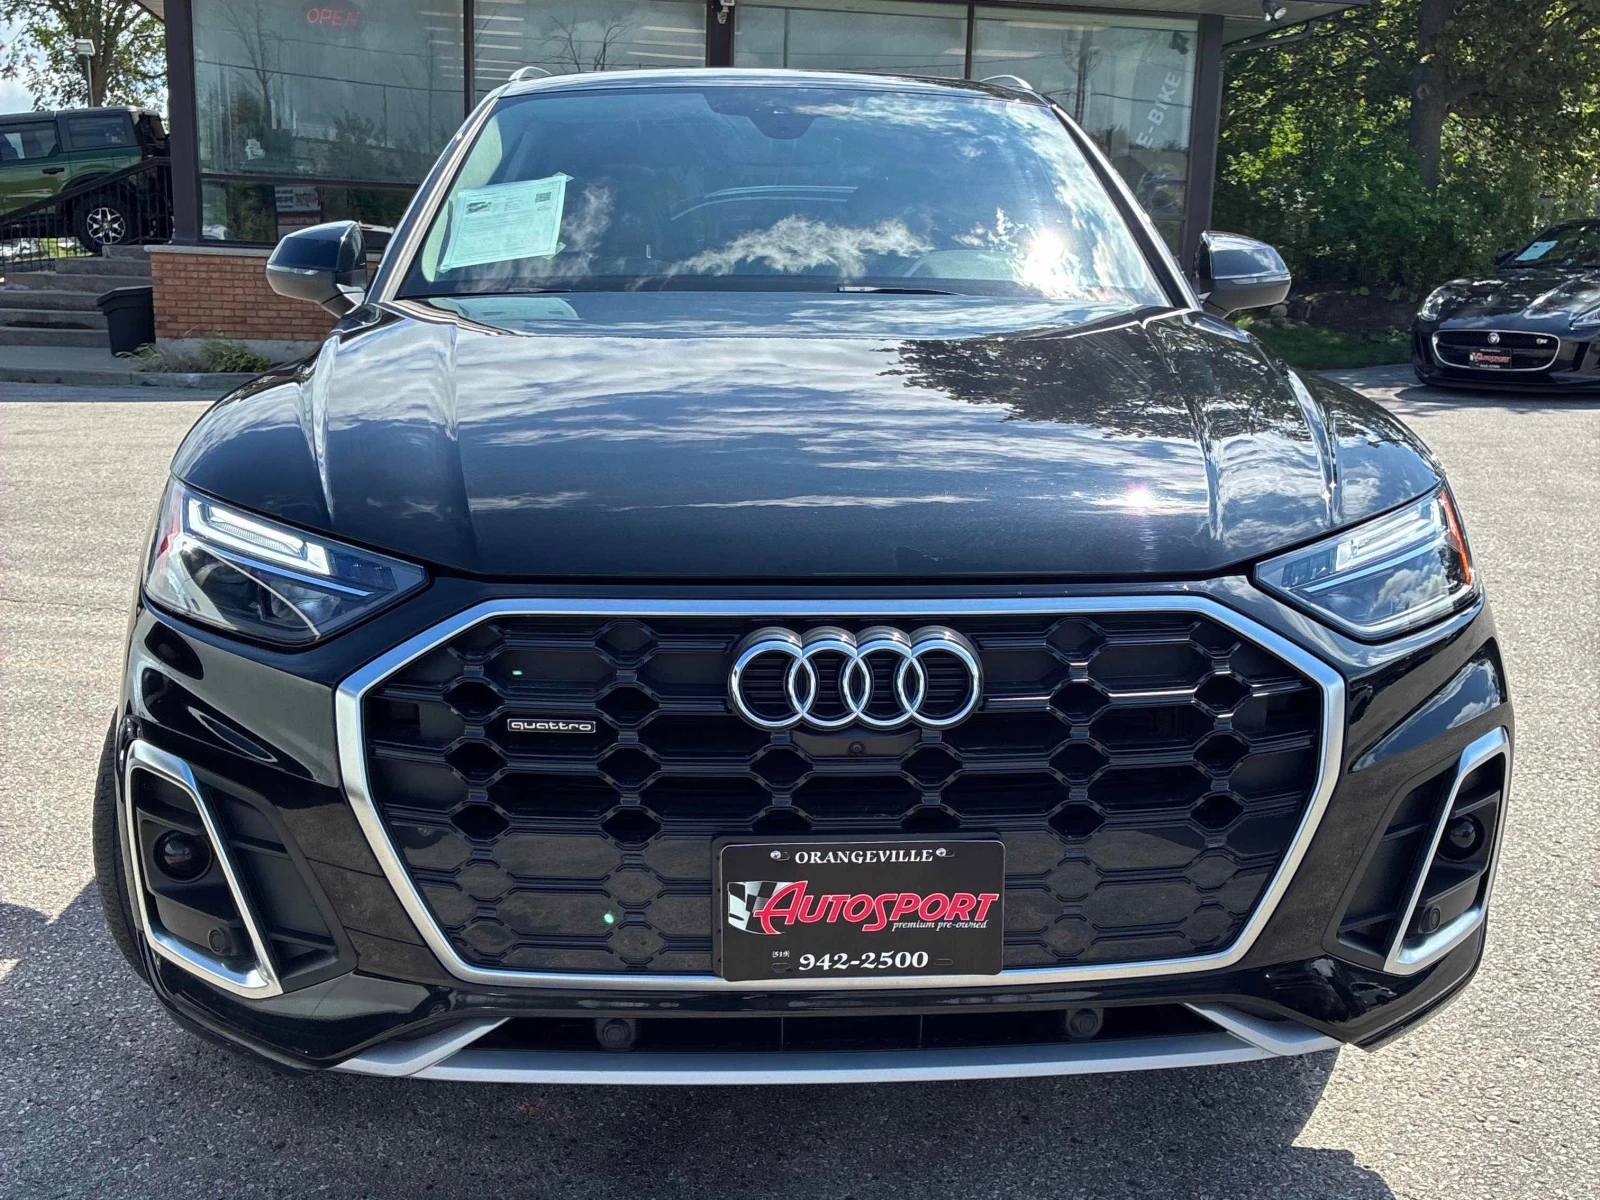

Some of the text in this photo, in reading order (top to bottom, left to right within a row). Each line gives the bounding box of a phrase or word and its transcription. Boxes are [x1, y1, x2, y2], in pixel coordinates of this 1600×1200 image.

[306, 8, 360, 26] OPEN
[1135, 71, 1182, 149] E-BIKE
[511, 721, 592, 731] quattro
[794, 849, 934, 865] ORANGEVILLE
[753, 880, 1000, 935] AUTOSPORT
[891, 919, 990, 932] premium pre-owned
[798, 951, 929, 971] 942-2500
